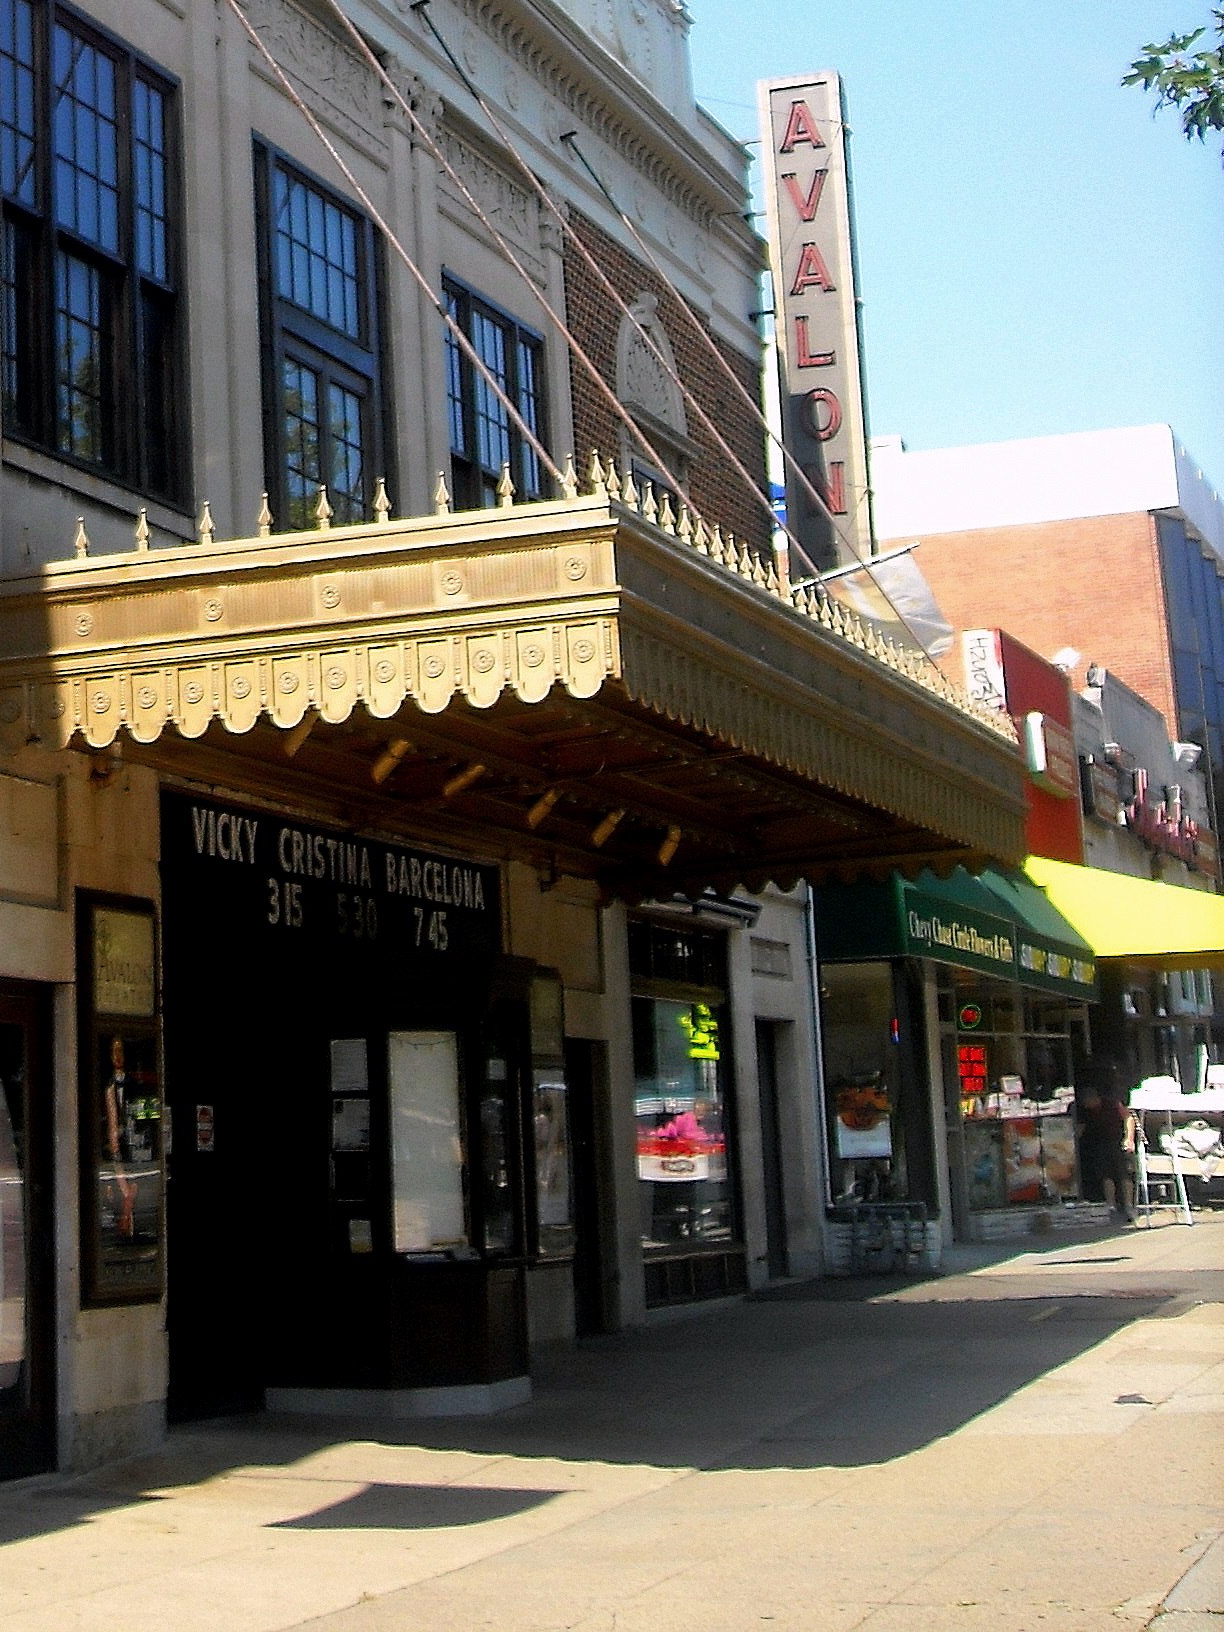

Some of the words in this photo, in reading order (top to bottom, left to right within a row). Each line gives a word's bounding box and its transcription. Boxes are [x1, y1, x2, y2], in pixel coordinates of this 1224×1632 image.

[778, 99, 849, 518] AVALON
[190, 806, 260, 866] VICKY
[276, 827, 373, 891] CRISTINA
[384, 852, 487, 913] BARCELONA
